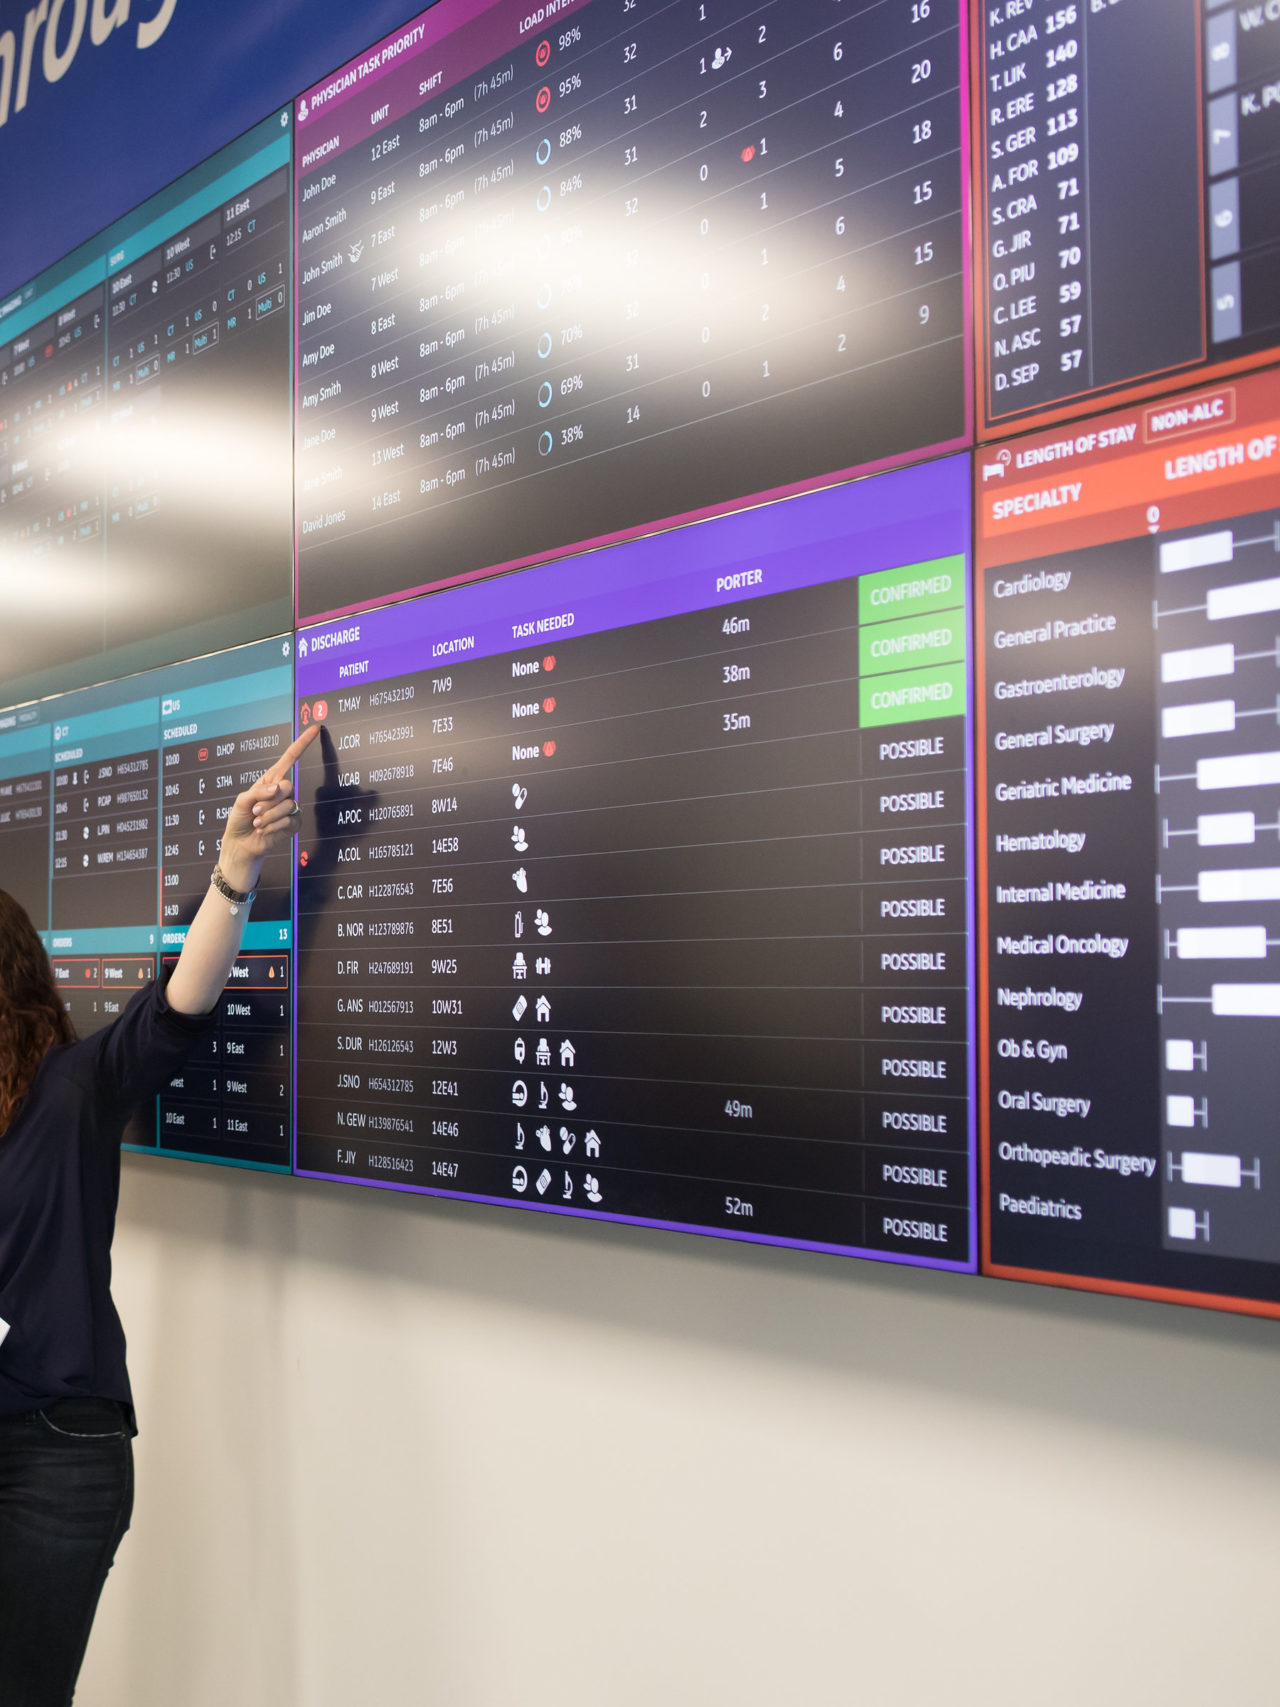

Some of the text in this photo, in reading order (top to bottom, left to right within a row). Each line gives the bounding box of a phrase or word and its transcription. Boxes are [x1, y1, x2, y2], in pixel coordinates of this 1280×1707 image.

[519, 9, 544, 34] LOAD
[1045, 5, 1077, 34] 156
[558, 26, 581, 51] 98%
[1006, 24, 1037, 53] CAA
[623, 43, 637, 63] 32
[833, 42, 842, 61] 6
[1046, 39, 1078, 69] 140
[311, 24, 425, 110] PHYSICIAN TASK PRIORITY
[912, 59, 931, 84] 20
[1003, 63, 1026, 88] LIK
[419, 71, 443, 96] SHIFT
[474, 64, 514, 102] (7h 45m)
[558, 73, 581, 98] 95%
[371, 104, 389, 125] UNIT
[419, 97, 464, 134] 8am 6pm
[1047, 107, 1078, 137] 113
[559, 124, 582, 148] 88%
[913, 120, 932, 144] 18
[1006, 126, 1036, 153] GER
[302, 136, 340, 168] PHYSICIAN
[371, 134, 400, 161] 12 East
[302, 173, 336, 202] John Doe
[371, 181, 395, 205] 9 East
[913, 181, 932, 204] 15
[1057, 177, 1079, 200] 71
[226, 199, 250, 221] 11 East
[1006, 194, 1037, 221] CRA
[247, 219, 256, 233] CT
[302, 208, 347, 244] Aaron Smith
[302, 253, 343, 281] John Smith
[1059, 281, 1082, 304] 59
[302, 302, 332, 326] Jim Doe
[919, 305, 930, 326] 9
[1010, 295, 1037, 321] LEE
[302, 342, 335, 368] Amy Doe
[371, 356, 399, 378] 8 West
[560, 374, 583, 396] 69%
[1151, 399, 1224, 432] NON-ALC
[561, 425, 583, 446] 38%
[1016, 423, 1136, 469] LENGTH OF STAY
[1164, 435, 1277, 481] LENGTH OF
[992, 481, 1082, 520] SPECIALTY
[1147, 505, 1160, 523] 0
[715, 566, 763, 593] PORTER
[869, 573, 952, 607] CONFIRMED
[993, 569, 1072, 599] Cardiology
[512, 612, 574, 639] TASK NEEDED
[722, 615, 751, 635] 46m
[994, 614, 1116, 650] General Practice
[311, 626, 360, 652] DISCHARGE
[432, 635, 475, 657] LOCATION
[339, 660, 369, 678] PATIENT
[512, 658, 539, 678] None
[722, 663, 751, 683] 38m
[432, 677, 452, 694] 7W9
[994, 666, 1125, 701] Gastroenterology
[172, 700, 180, 711] US
[338, 696, 361, 713] T.MAY
[369, 686, 414, 707] H675432190
[870, 681, 953, 711] CONFIRMED
[163, 723, 198, 740] SCHEDULED
[432, 716, 453, 734] 7E33
[722, 710, 751, 732] 35m
[240, 734, 279, 752] H765418210
[338, 734, 360, 751] J.COR
[995, 721, 1115, 751] General Surgery
[165, 753, 179, 765] 10:00
[216, 743, 234, 757] D.HOP
[879, 737, 944, 761] POSSIBLE
[432, 757, 453, 774] 7E46
[165, 784, 179, 796] 10:45
[216, 775, 232, 788] S.THA
[338, 772, 360, 787] V.CAB
[995, 771, 1132, 802] Geriatric Medicine
[337, 808, 362, 825] A.POC
[432, 797, 457, 814] 8W14
[369, 843, 414, 860] H165785121
[432, 837, 459, 854] 14E58
[996, 829, 1086, 855] Hematology
[337, 846, 361, 863] A.COL
[165, 874, 179, 886] 13:00
[432, 878, 453, 894] 7E56
[996, 879, 1126, 903] Internal Medicine
[337, 884, 363, 899] C. CAR
[880, 897, 946, 919] POSSIBLE
[279, 929, 287, 940] 13
[337, 922, 364, 937] B. NOR
[431, 919, 453, 935] 8E51
[163, 933, 186, 944] ORDERS
[997, 934, 1129, 957] Medical Oncology
[369, 960, 414, 975] H247689191
[227, 1004, 251, 1016] 10 West
[337, 999, 363, 1014] G. ANS
[432, 999, 463, 1015] 10W31
[997, 987, 1083, 1012] Nephrology
[432, 1040, 457, 1056] 12W3
[997, 1038, 1068, 1063] Ob & Gyn
[881, 1057, 947, 1080] POSSIBLE
[337, 1074, 360, 1089] J.SNO
[432, 1080, 459, 1097] 12E41
[998, 1090, 1091, 1118] Oral Surgery
[337, 1111, 365, 1128] N. GEW
[432, 1120, 459, 1137] 14E46
[998, 1141, 1157, 1177] Orthopeadic Surgery
[725, 1196, 753, 1217] 52m
[999, 1192, 1082, 1221] Paediatrics
